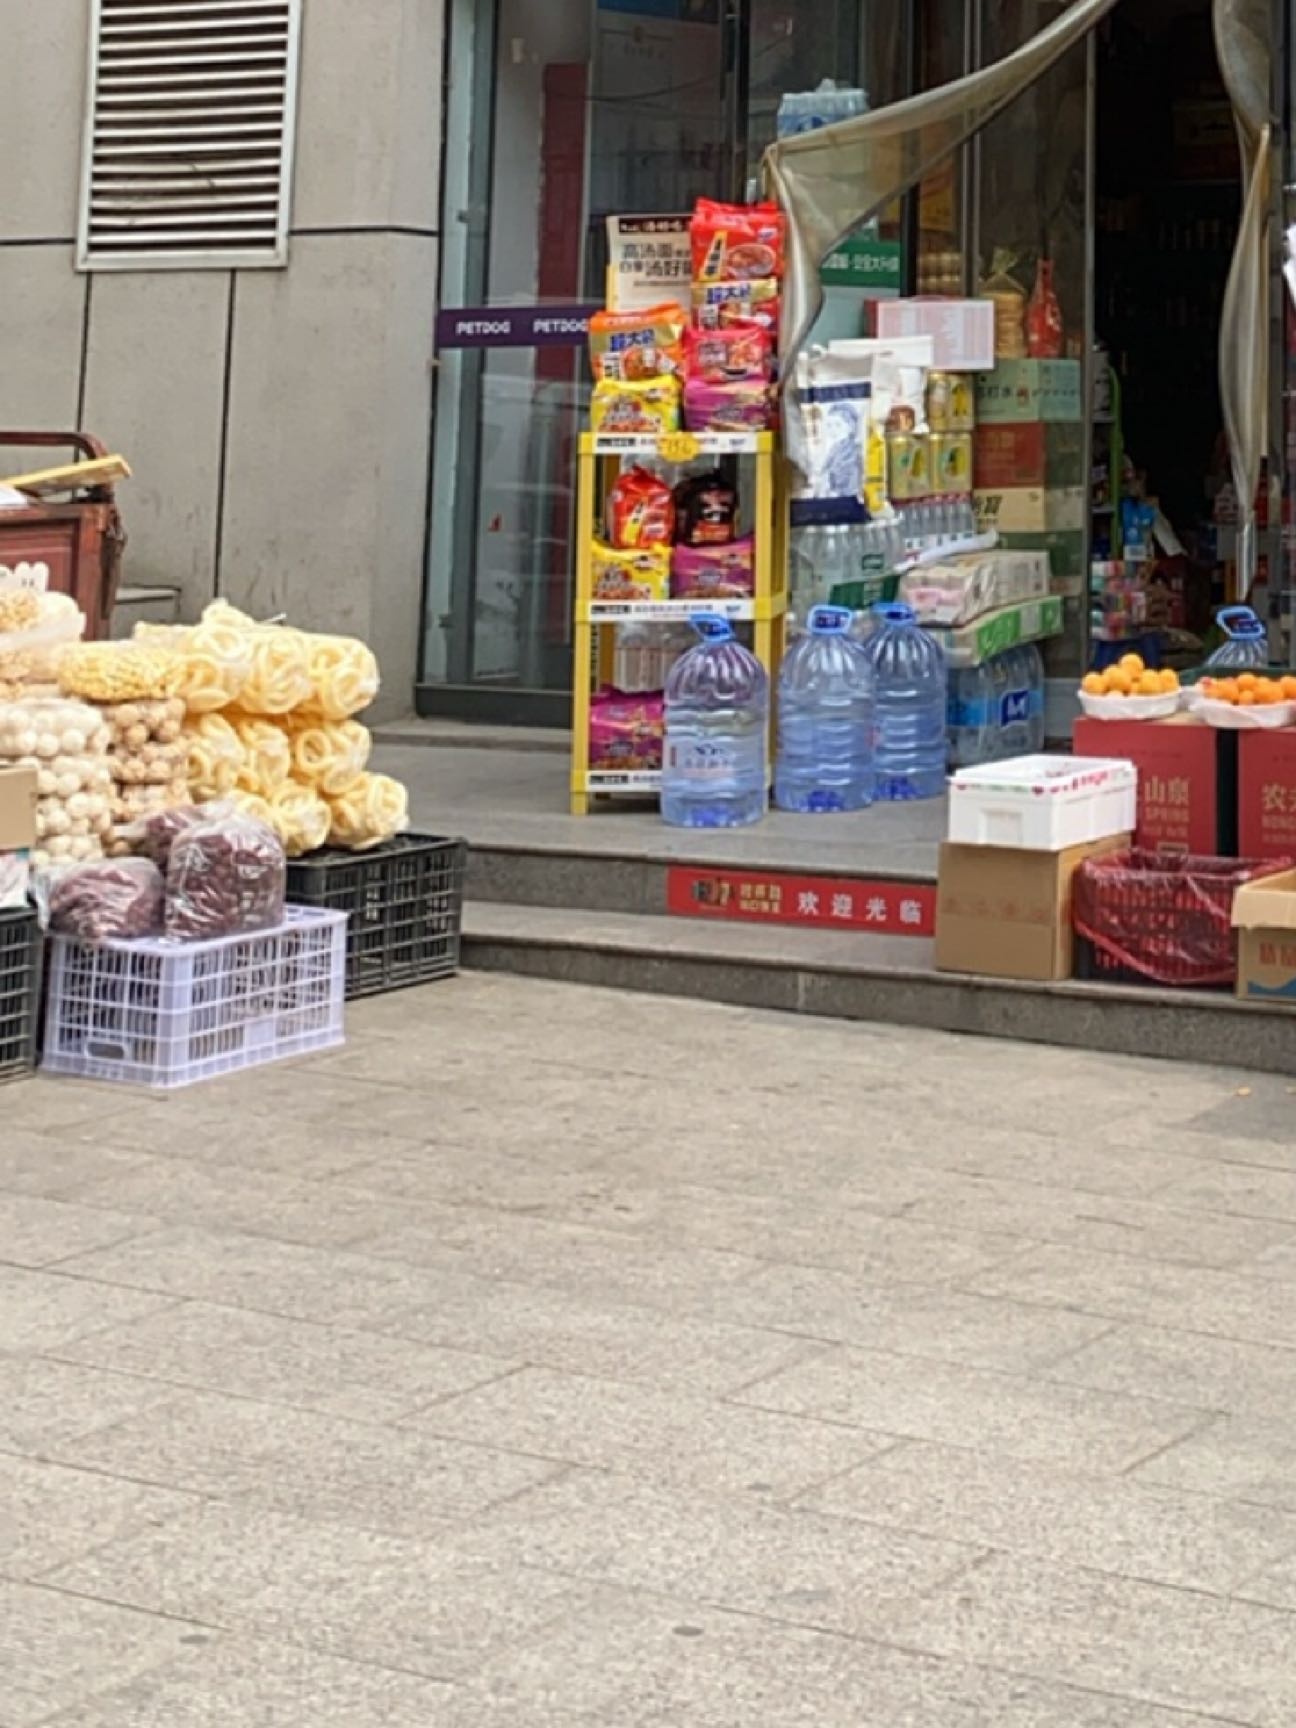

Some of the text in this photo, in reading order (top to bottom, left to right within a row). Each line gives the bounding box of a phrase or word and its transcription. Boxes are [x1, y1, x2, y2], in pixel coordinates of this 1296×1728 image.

[456, 320, 511, 335] PETDOG
[798, 890, 922, 924] 欢迎光临
